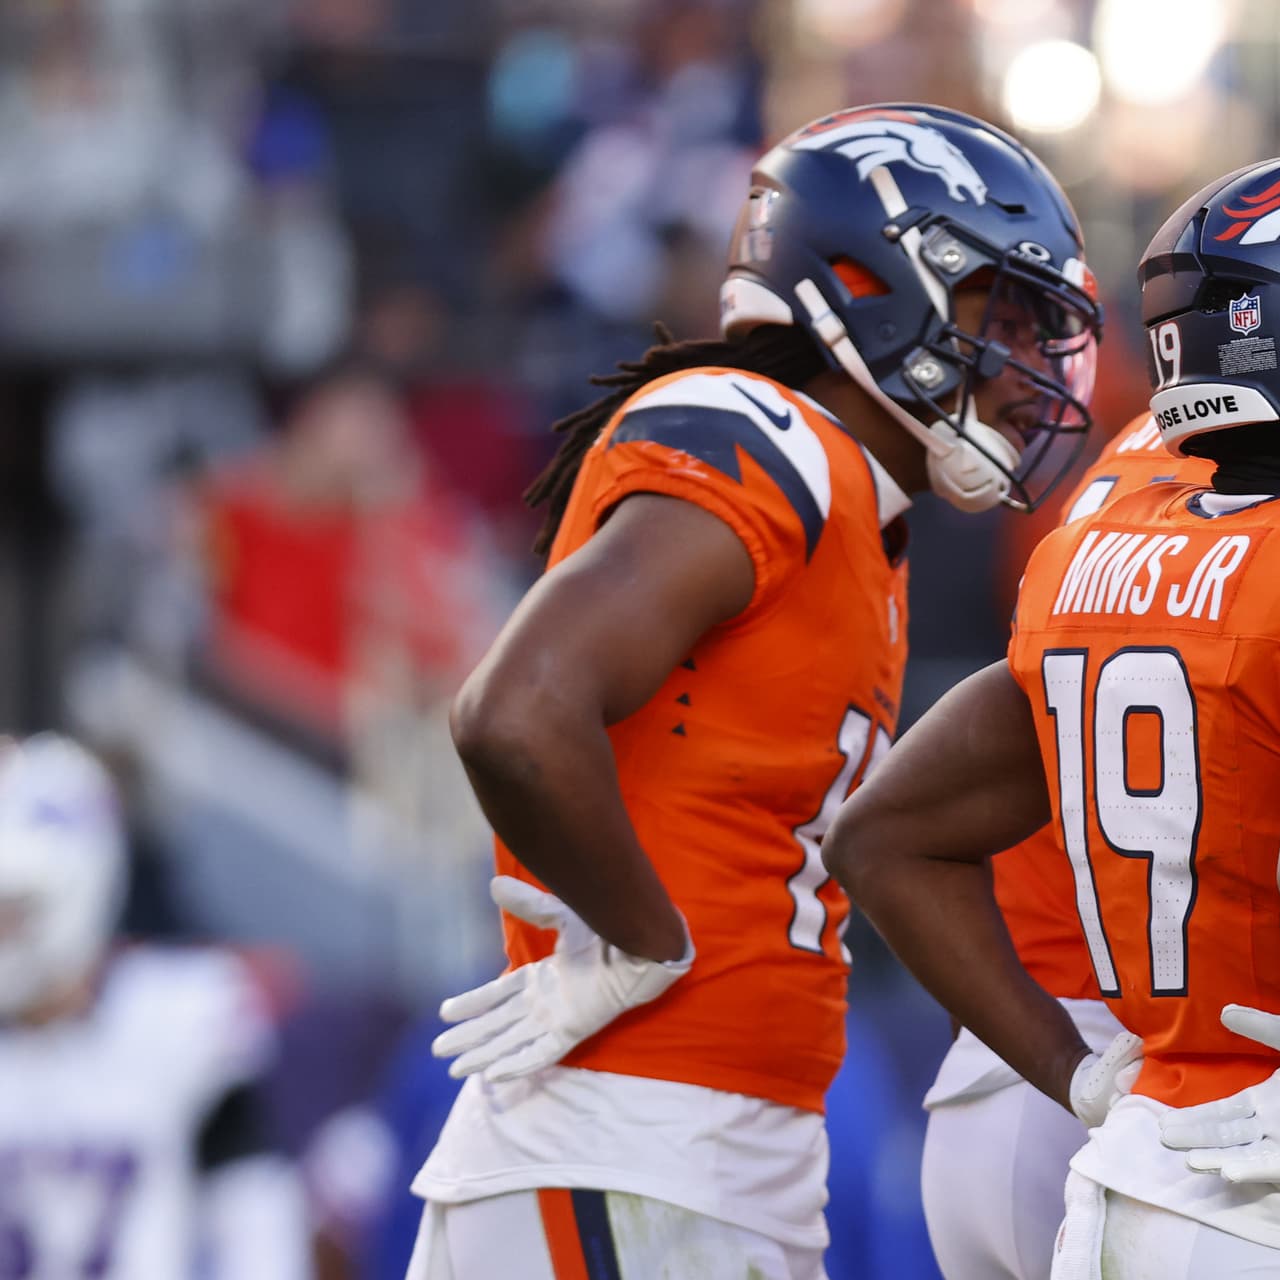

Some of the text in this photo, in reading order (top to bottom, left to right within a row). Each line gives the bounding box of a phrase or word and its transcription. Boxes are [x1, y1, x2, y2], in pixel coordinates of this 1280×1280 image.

[1234, 310, 1257, 328] NFL
[1149, 320, 1181, 387] 19
[1182, 395, 1239, 421] LOVE
[1052, 530, 1251, 621] MIMS JR
[1042, 645, 1200, 998] 19
